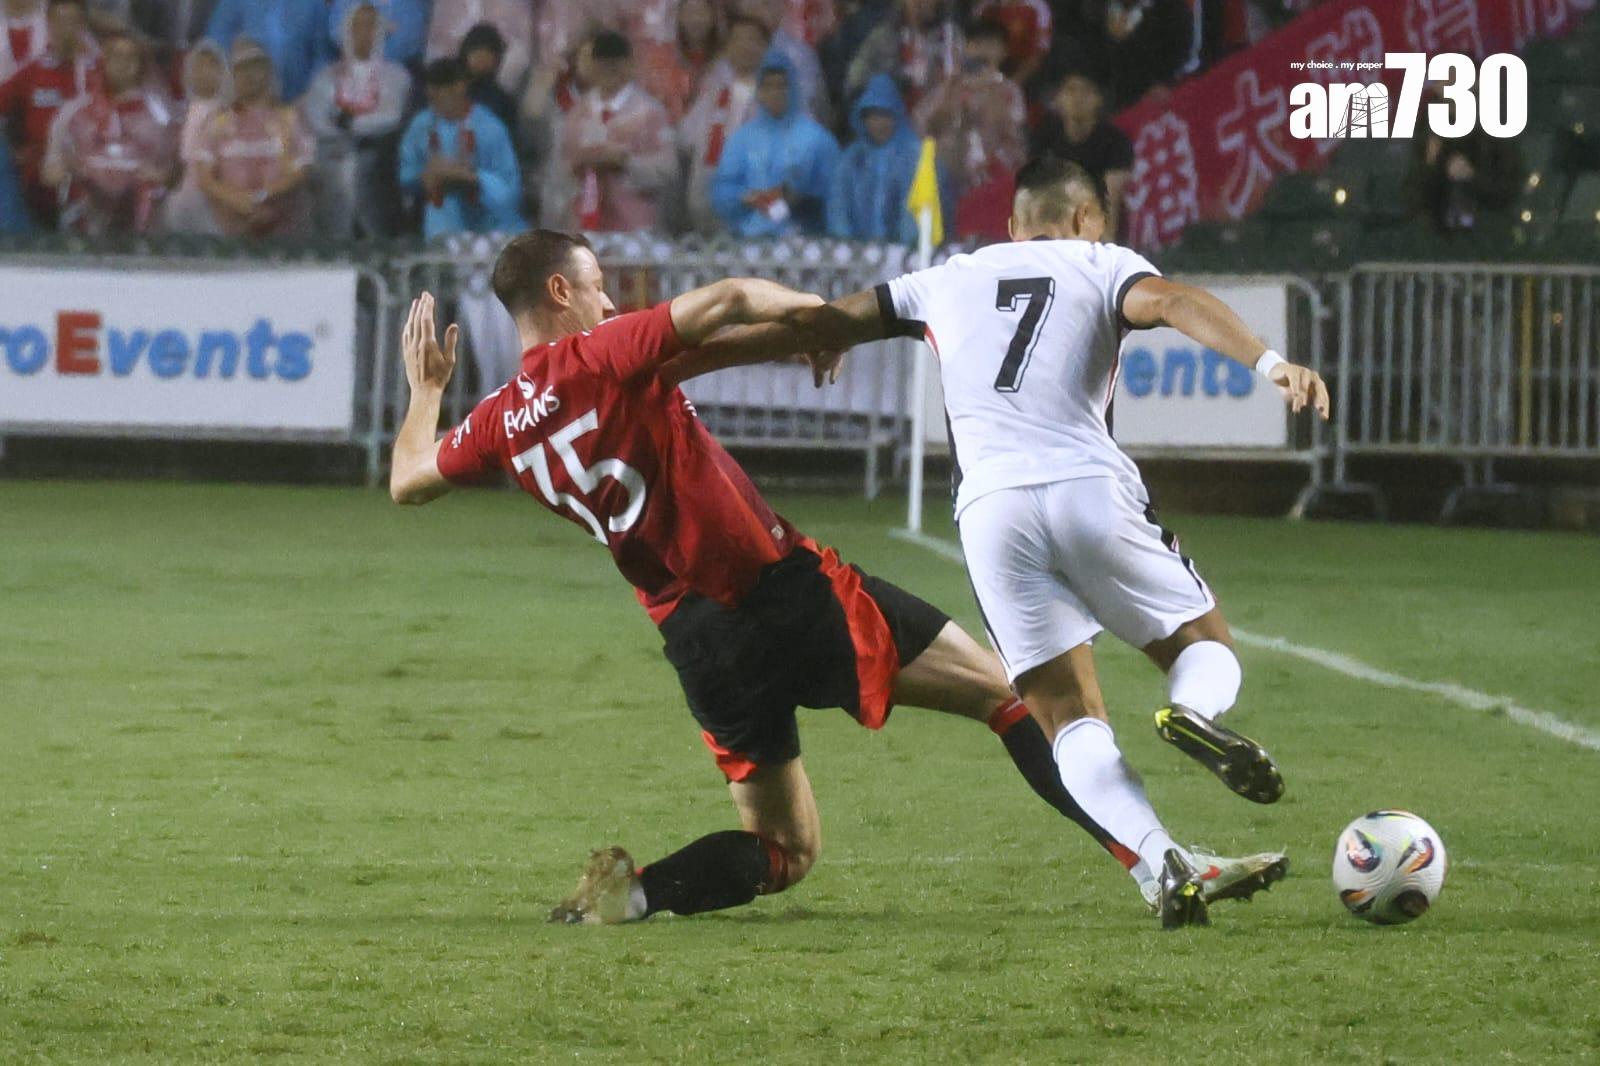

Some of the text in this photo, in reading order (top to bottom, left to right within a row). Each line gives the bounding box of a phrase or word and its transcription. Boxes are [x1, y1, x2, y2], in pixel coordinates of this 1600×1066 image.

[994, 276, 1056, 393] 7
[1122, 344, 1254, 397] ents
[503, 385, 561, 439] EVANS
[511, 408, 647, 546] 35
